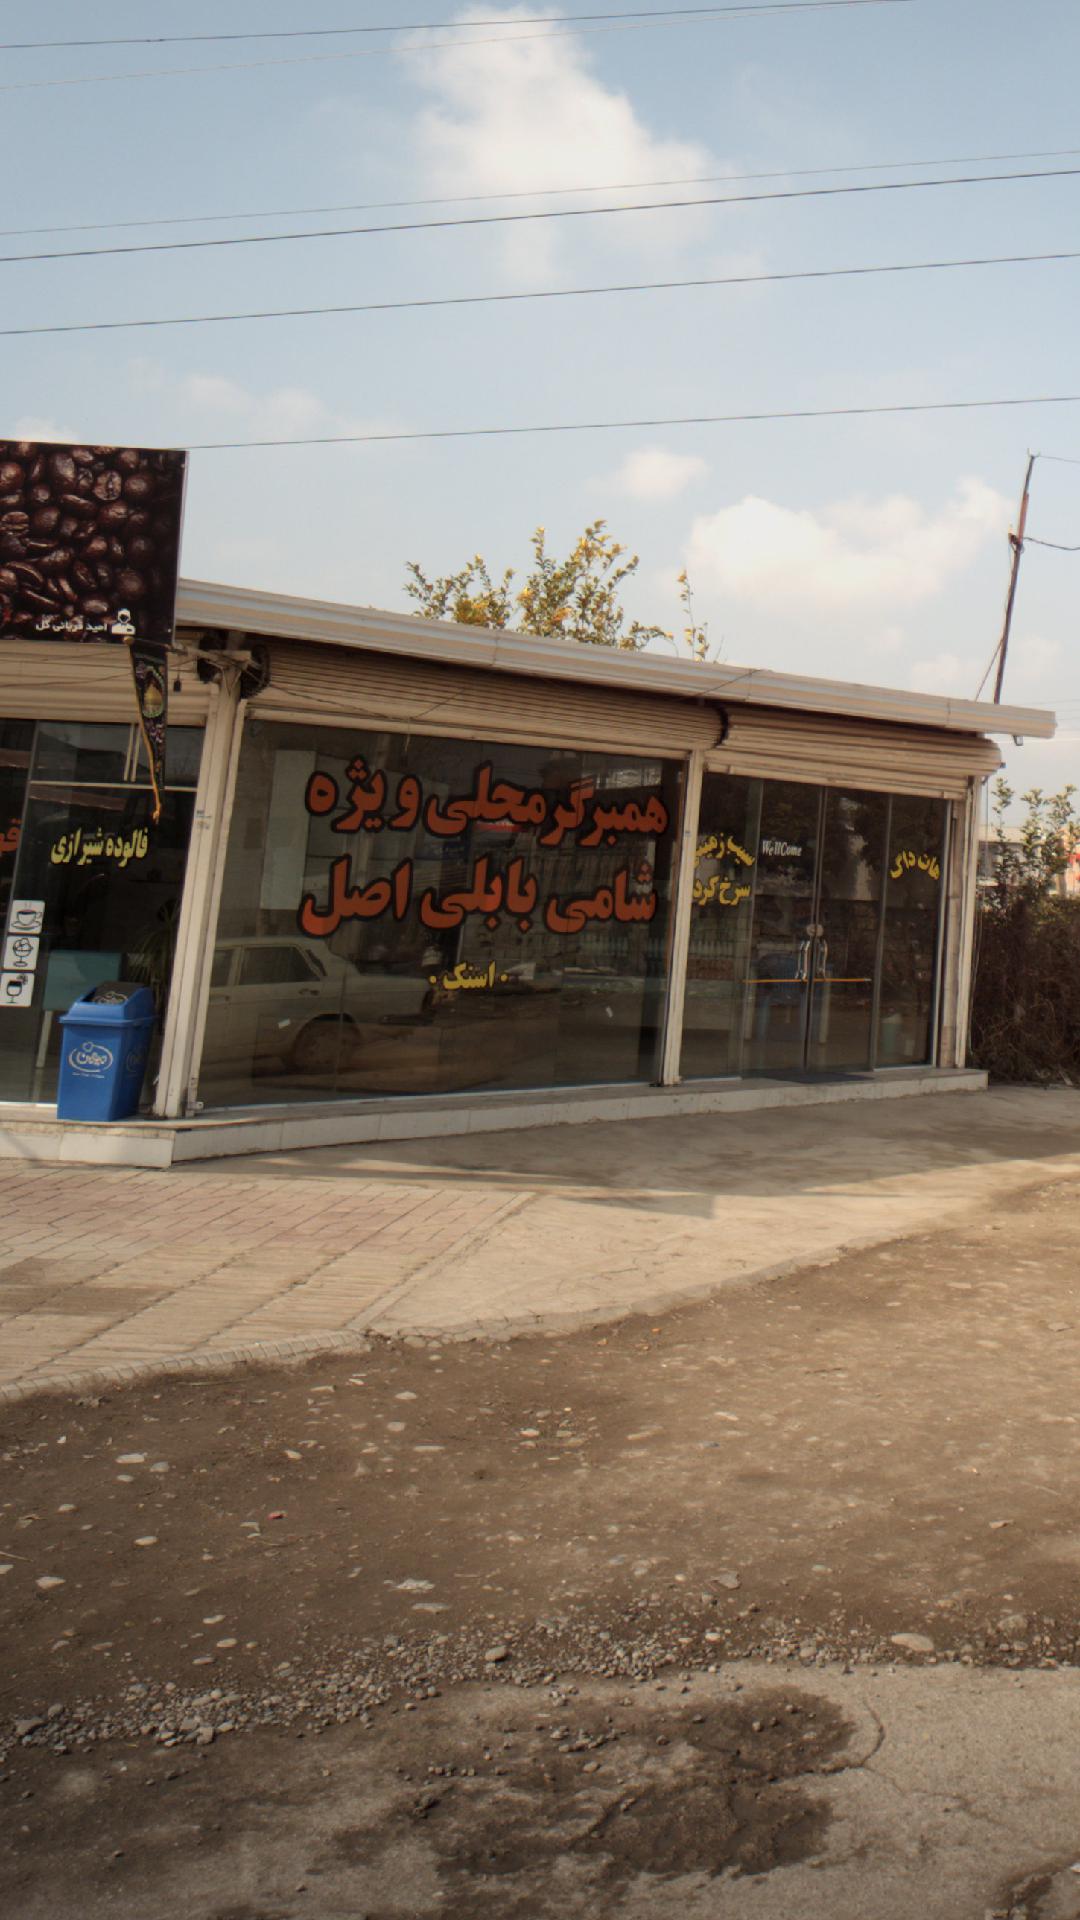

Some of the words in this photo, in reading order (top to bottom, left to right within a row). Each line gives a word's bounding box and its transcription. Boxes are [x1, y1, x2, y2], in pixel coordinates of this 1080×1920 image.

[305, 755, 423, 834] ویژه
[425, 760, 548, 836] محلی
[539, 776, 669, 847] همبرگر
[50, 826, 104, 866] شیرازی
[105, 826, 149, 868] فالوده
[727, 835, 756, 866] سیب
[917, 853, 940, 880] هات
[300, 853, 413, 936] اصل
[419, 855, 538, 933] بابلی
[545, 861, 657, 934] شامی
[693, 875, 720, 906] کرد
[719, 876, 751, 906] سرخ
[442, 960, 496, 990] اسنک
